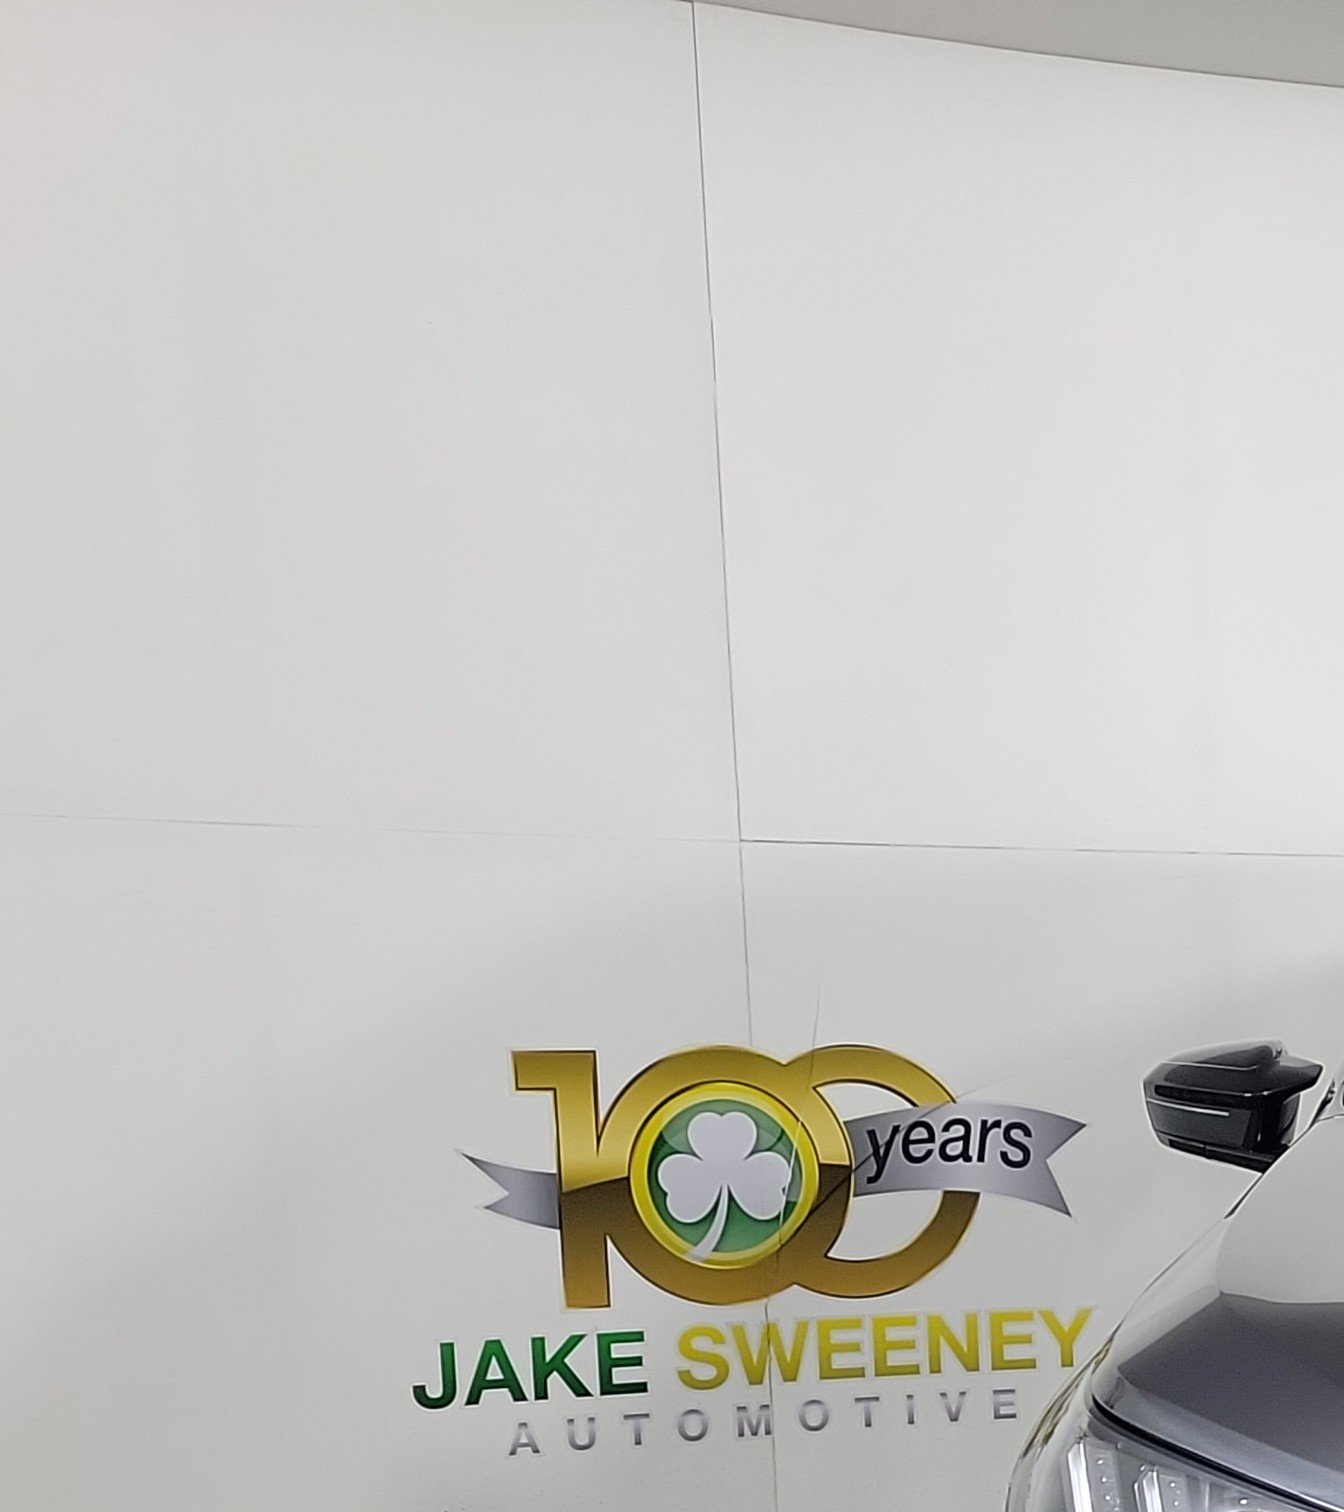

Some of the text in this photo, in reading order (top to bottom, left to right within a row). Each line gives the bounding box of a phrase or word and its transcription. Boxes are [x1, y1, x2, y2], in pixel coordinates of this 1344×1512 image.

[512, 1044, 1032, 1308] 100 years
[412, 1307, 1092, 1410] JAKE SWEENEY
[509, 1388, 1018, 1456] AUTOMOTIVE
